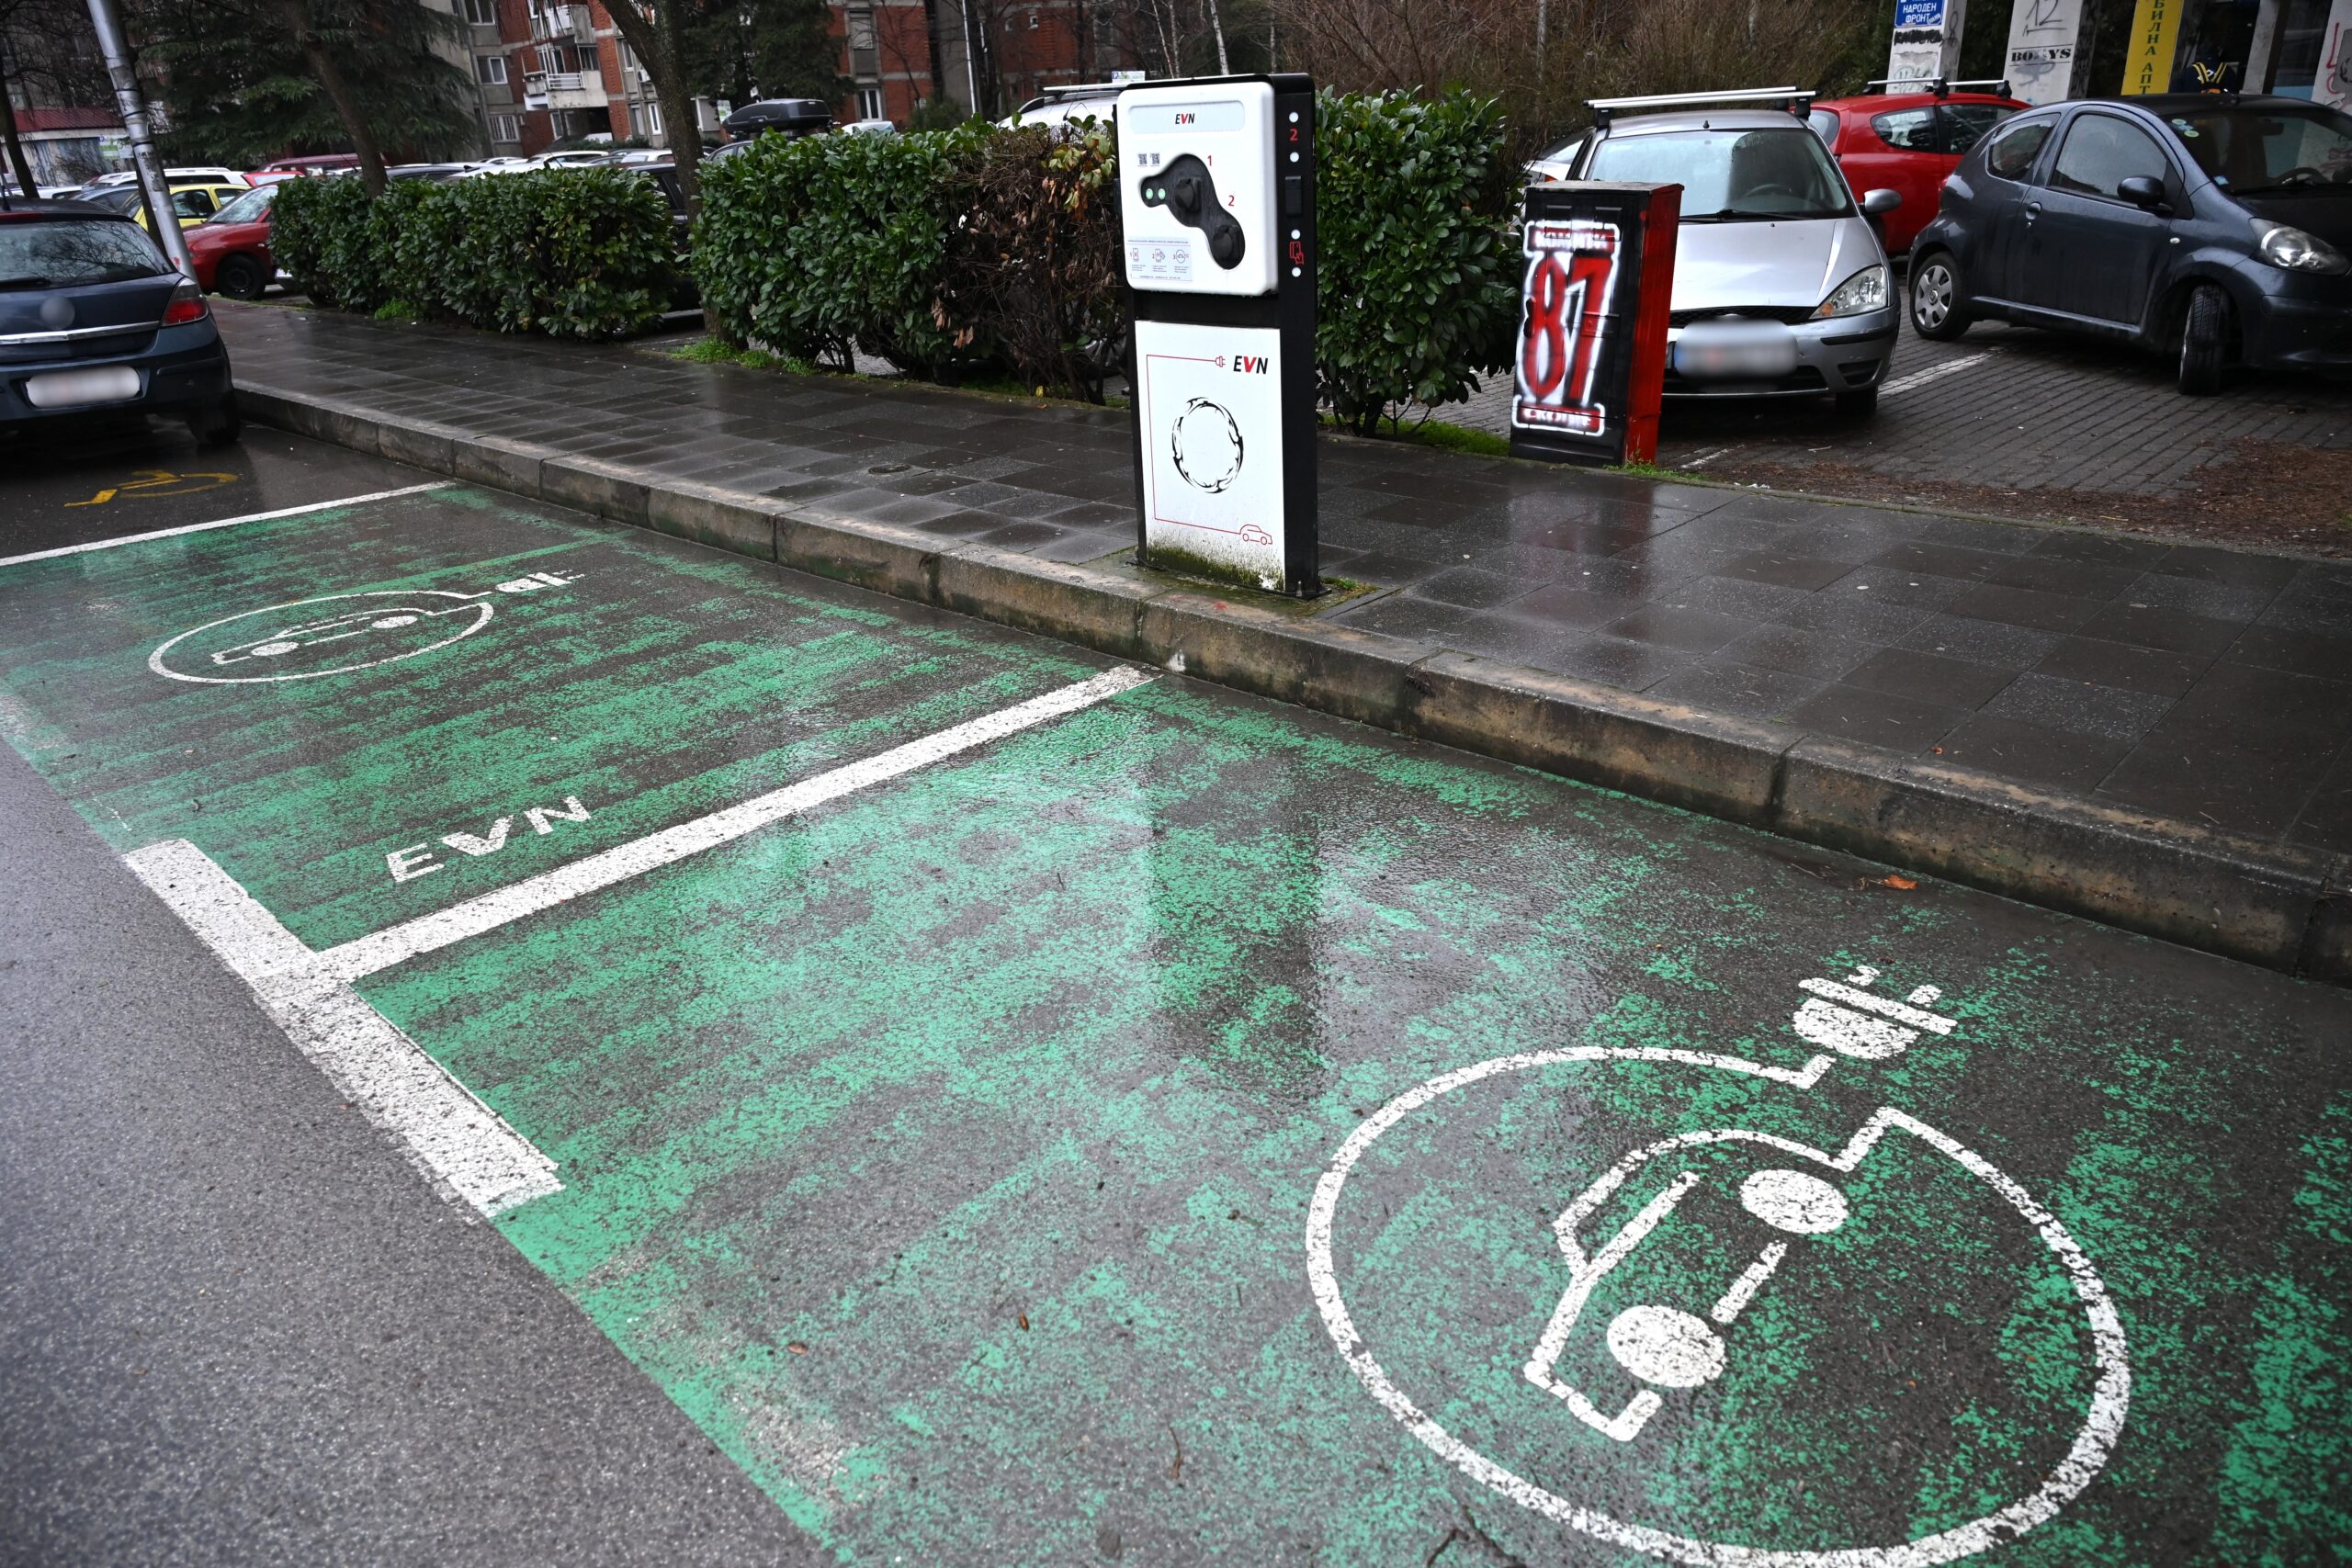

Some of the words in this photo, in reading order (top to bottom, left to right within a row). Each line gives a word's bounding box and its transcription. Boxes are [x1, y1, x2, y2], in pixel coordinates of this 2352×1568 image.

[1903, 3, 1937, 13] НАРОДЕН
[1905, 13, 1930, 23] ФРОНТ
[1175, 113, 1195, 125] EVN
[1289, 129, 1298, 141] 2
[1207, 154, 1213, 166] 1
[1227, 195, 1236, 207] 2
[1522, 254, 1614, 404] 87
[1233, 355, 1268, 375] EVN
[386, 795, 592, 883] EVN
